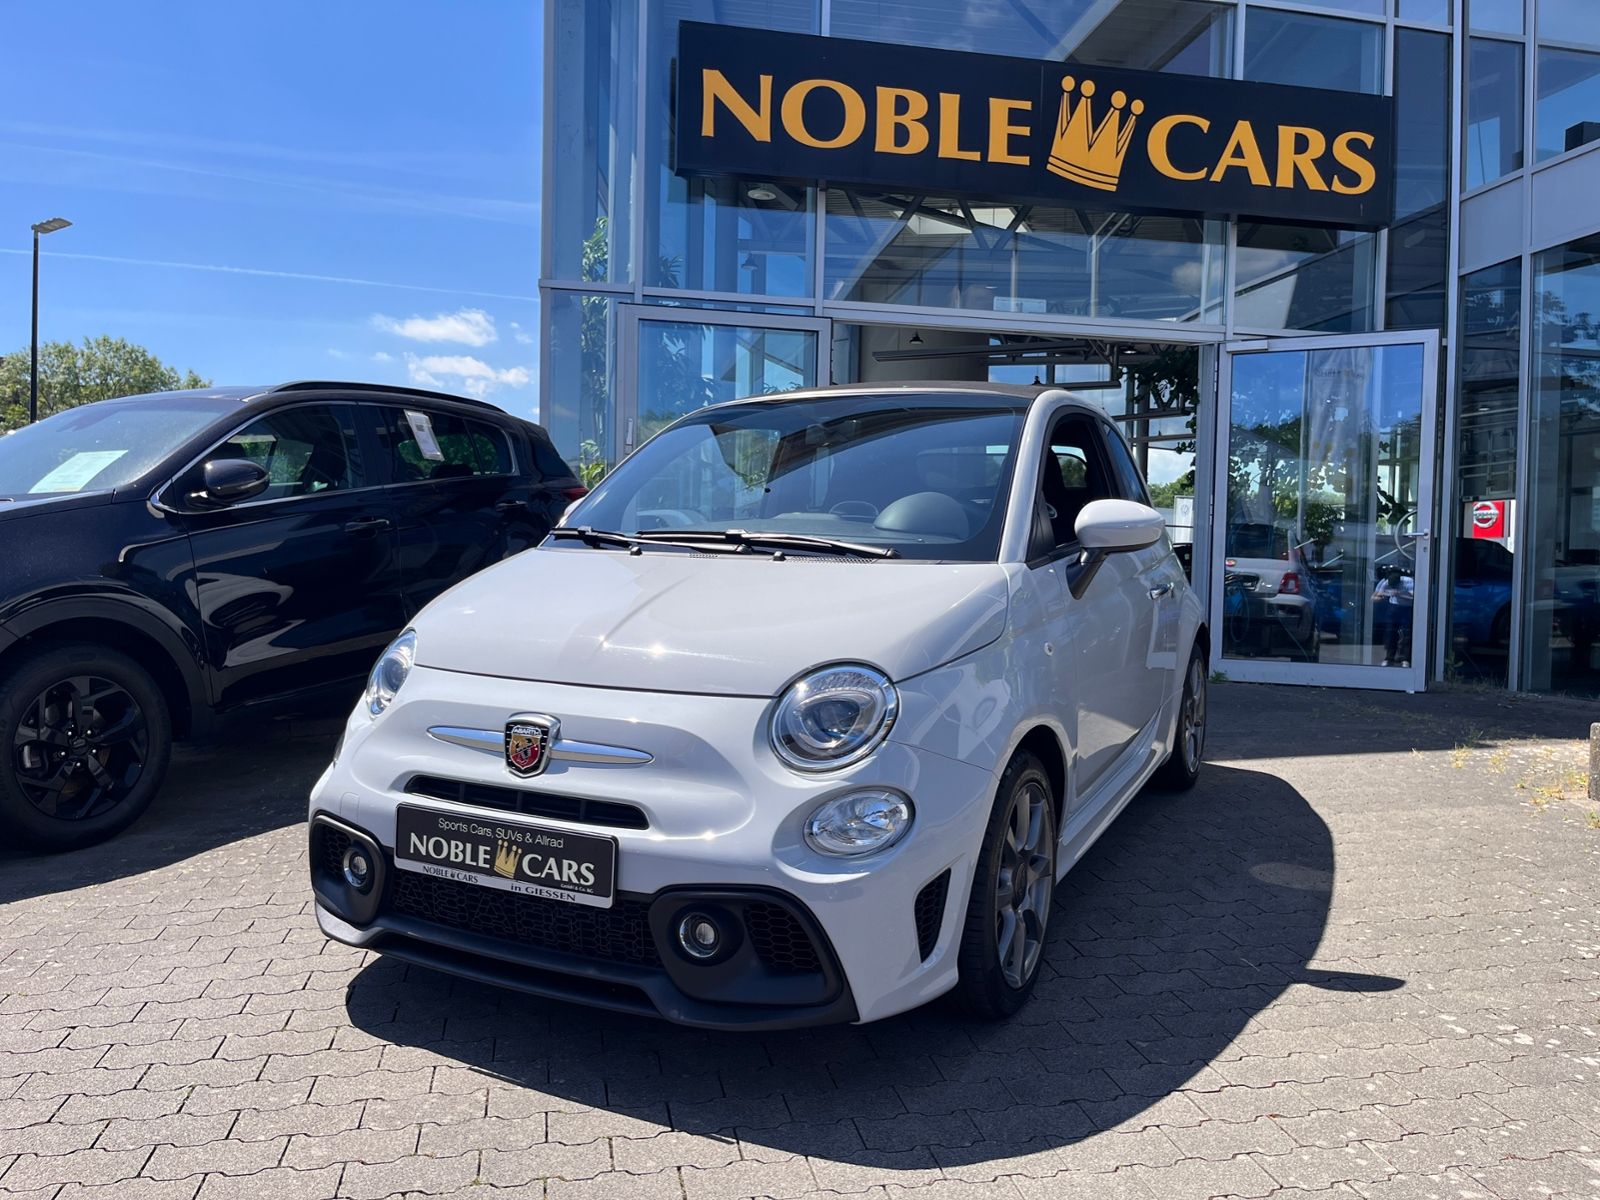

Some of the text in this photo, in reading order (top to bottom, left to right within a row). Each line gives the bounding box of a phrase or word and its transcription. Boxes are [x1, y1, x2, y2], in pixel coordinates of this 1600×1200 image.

[701, 69, 1376, 195] NOBLE CARS
[513, 727, 540, 736] ABARTH
[438, 818, 564, 848] Sports Cars, SUVs & Allrad
[410, 832, 595, 886] NOBLE CARS
[423, 865, 479, 883] NOBLE CARS
[510, 883, 576, 902] in GIESSEN
